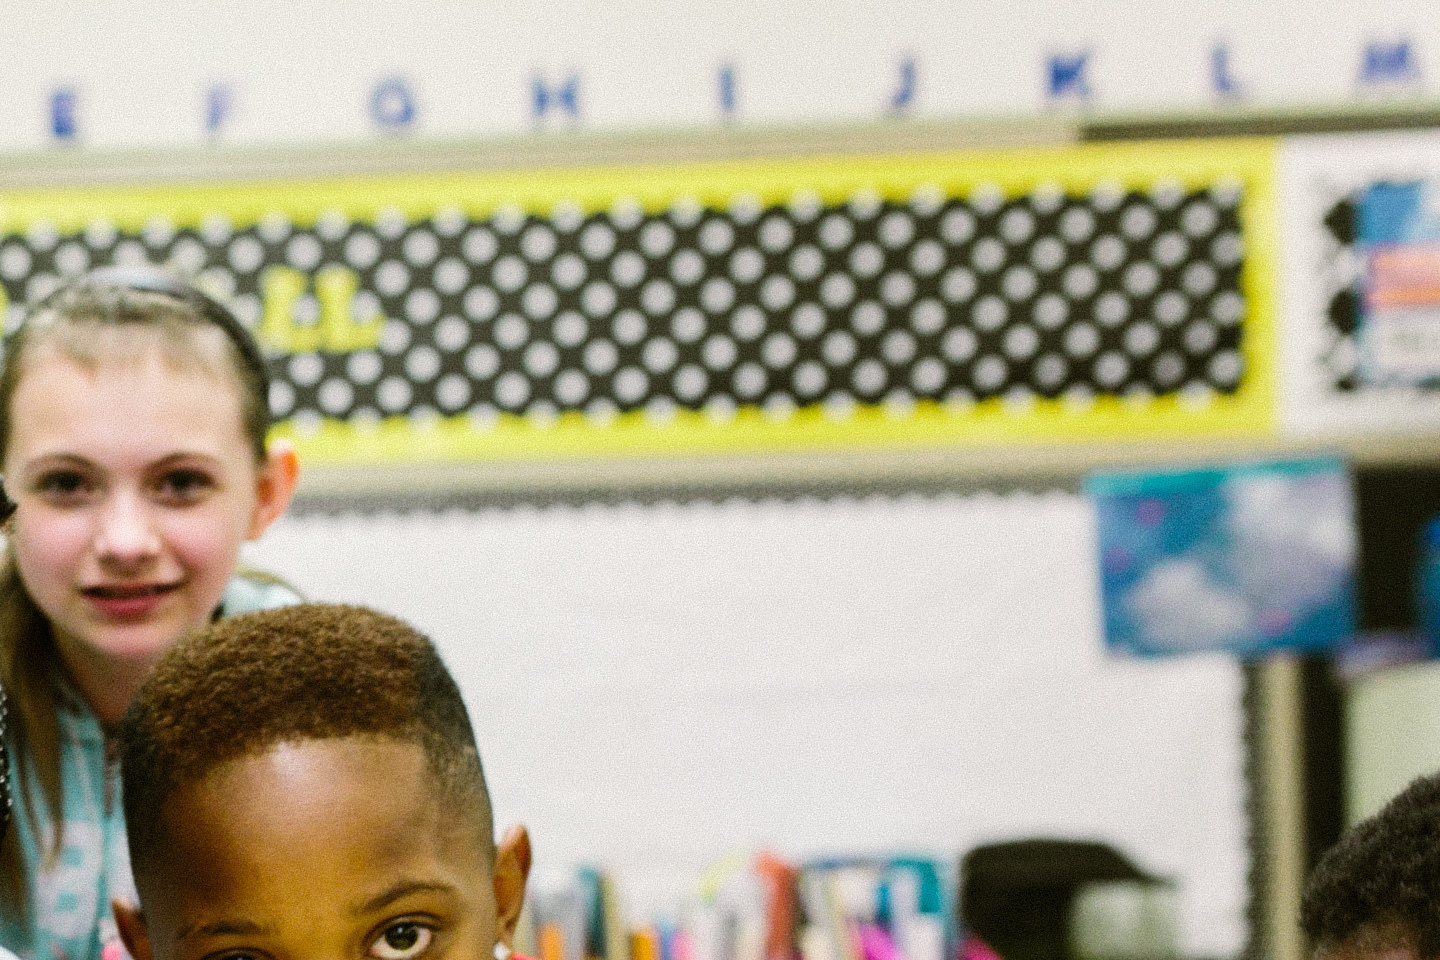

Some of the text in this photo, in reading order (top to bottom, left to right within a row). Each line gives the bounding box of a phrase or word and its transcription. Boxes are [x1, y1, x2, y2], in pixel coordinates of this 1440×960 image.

[531, 75, 580, 119] H
[891, 57, 919, 110] J
[1046, 54, 1088, 98] K
[1209, 42, 1242, 97] L
[1360, 39, 1418, 84] M
[260, 265, 386, 353] LL
